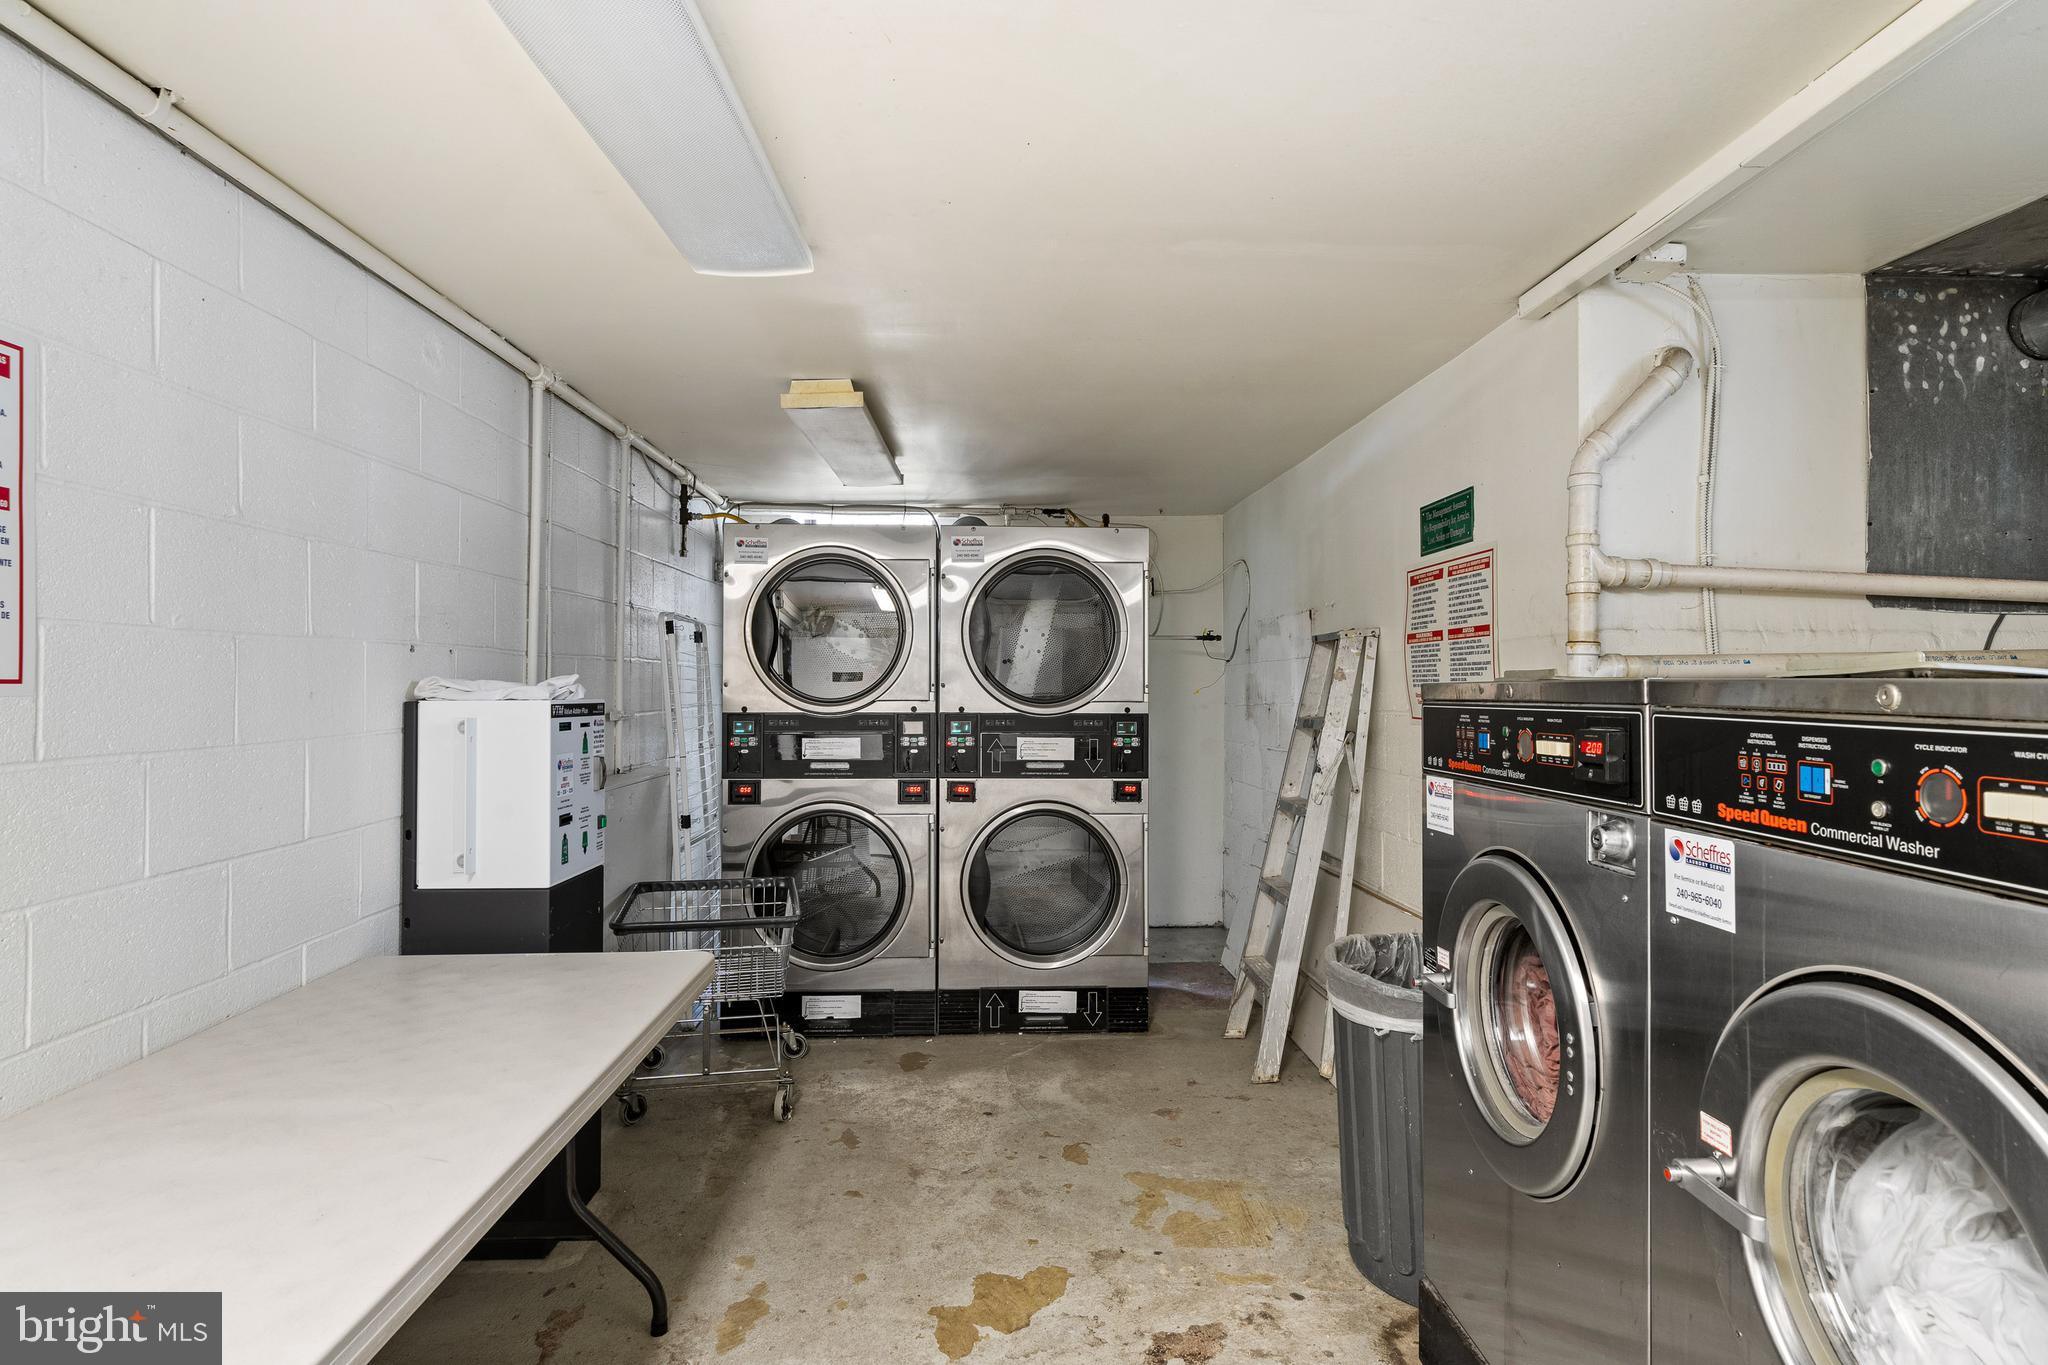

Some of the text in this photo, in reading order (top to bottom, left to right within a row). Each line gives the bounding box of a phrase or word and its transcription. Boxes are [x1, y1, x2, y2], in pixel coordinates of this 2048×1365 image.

[1747, 738, 1777, 746] INSTRUCTIONS
[1749, 732, 1774, 740] OPERATING
[1798, 742, 1832, 751] INSTRUCTIONS
[1914, 743, 1968, 754] CYCLE INDICATOR
[2013, 751, 2036, 760] WASH
[1448, 758, 1526, 780] Speed Queen Commercial Washer
[1435, 781, 1452, 795] Scheffres
[1717, 802, 1941, 859] Speed Queen Commercial Washer
[1685, 841, 1731, 865] Scheffres
[1686, 857, 1731, 874] LAUNDRY SERVICE
[1681, 874, 1695, 884] Service
[1701, 879, 1716, 890] Refund
[1716, 882, 1725, 892] Call
[1676, 887, 1722, 909] 240-965-6040
